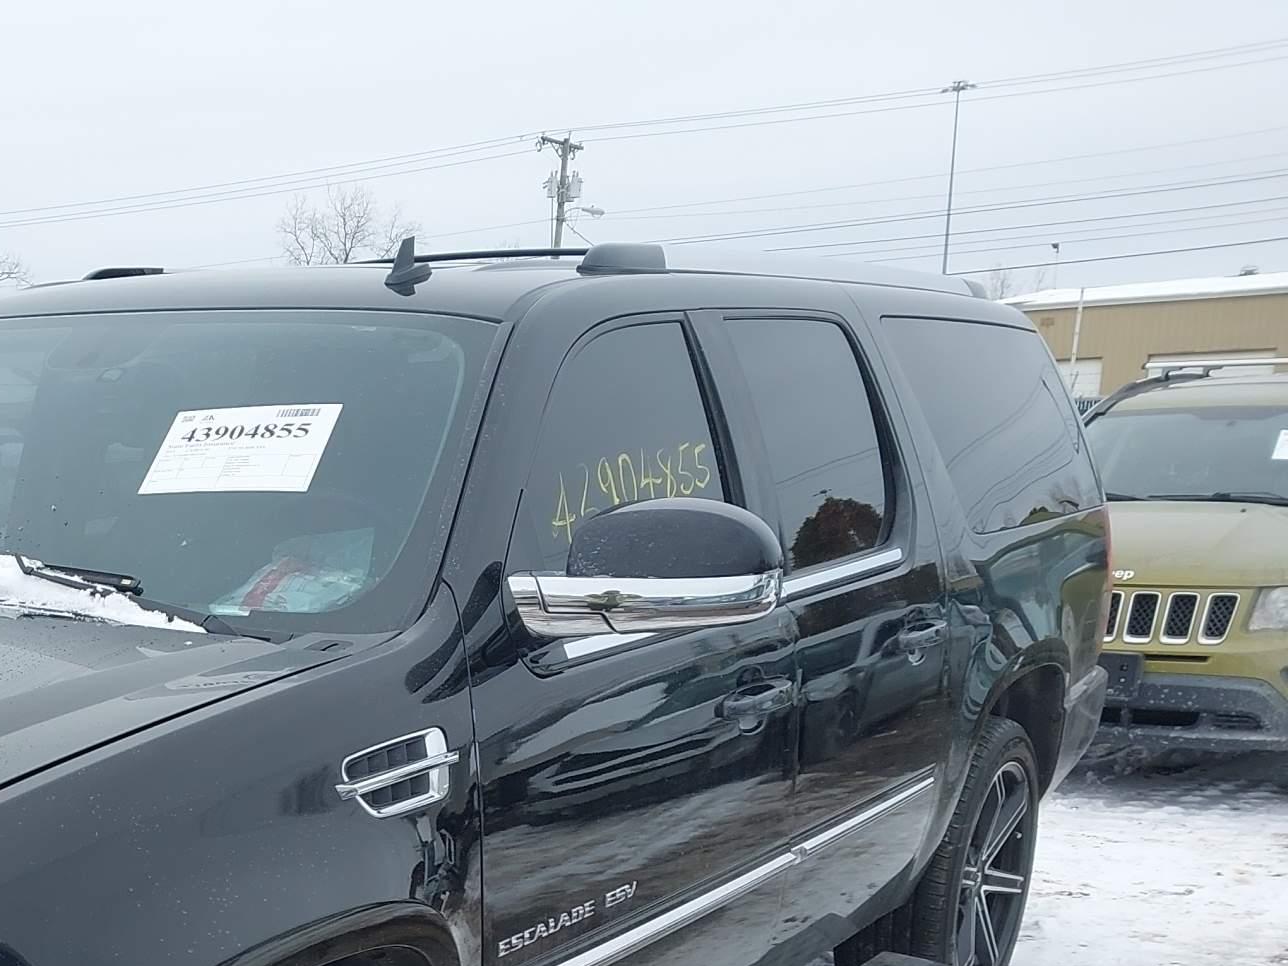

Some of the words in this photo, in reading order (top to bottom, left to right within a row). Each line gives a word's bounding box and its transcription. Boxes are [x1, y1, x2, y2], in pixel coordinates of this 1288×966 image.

[180, 422, 313, 443] 43904855
[497, 899, 596, 958] ESCALADE
[605, 880, 638, 909] ESV
